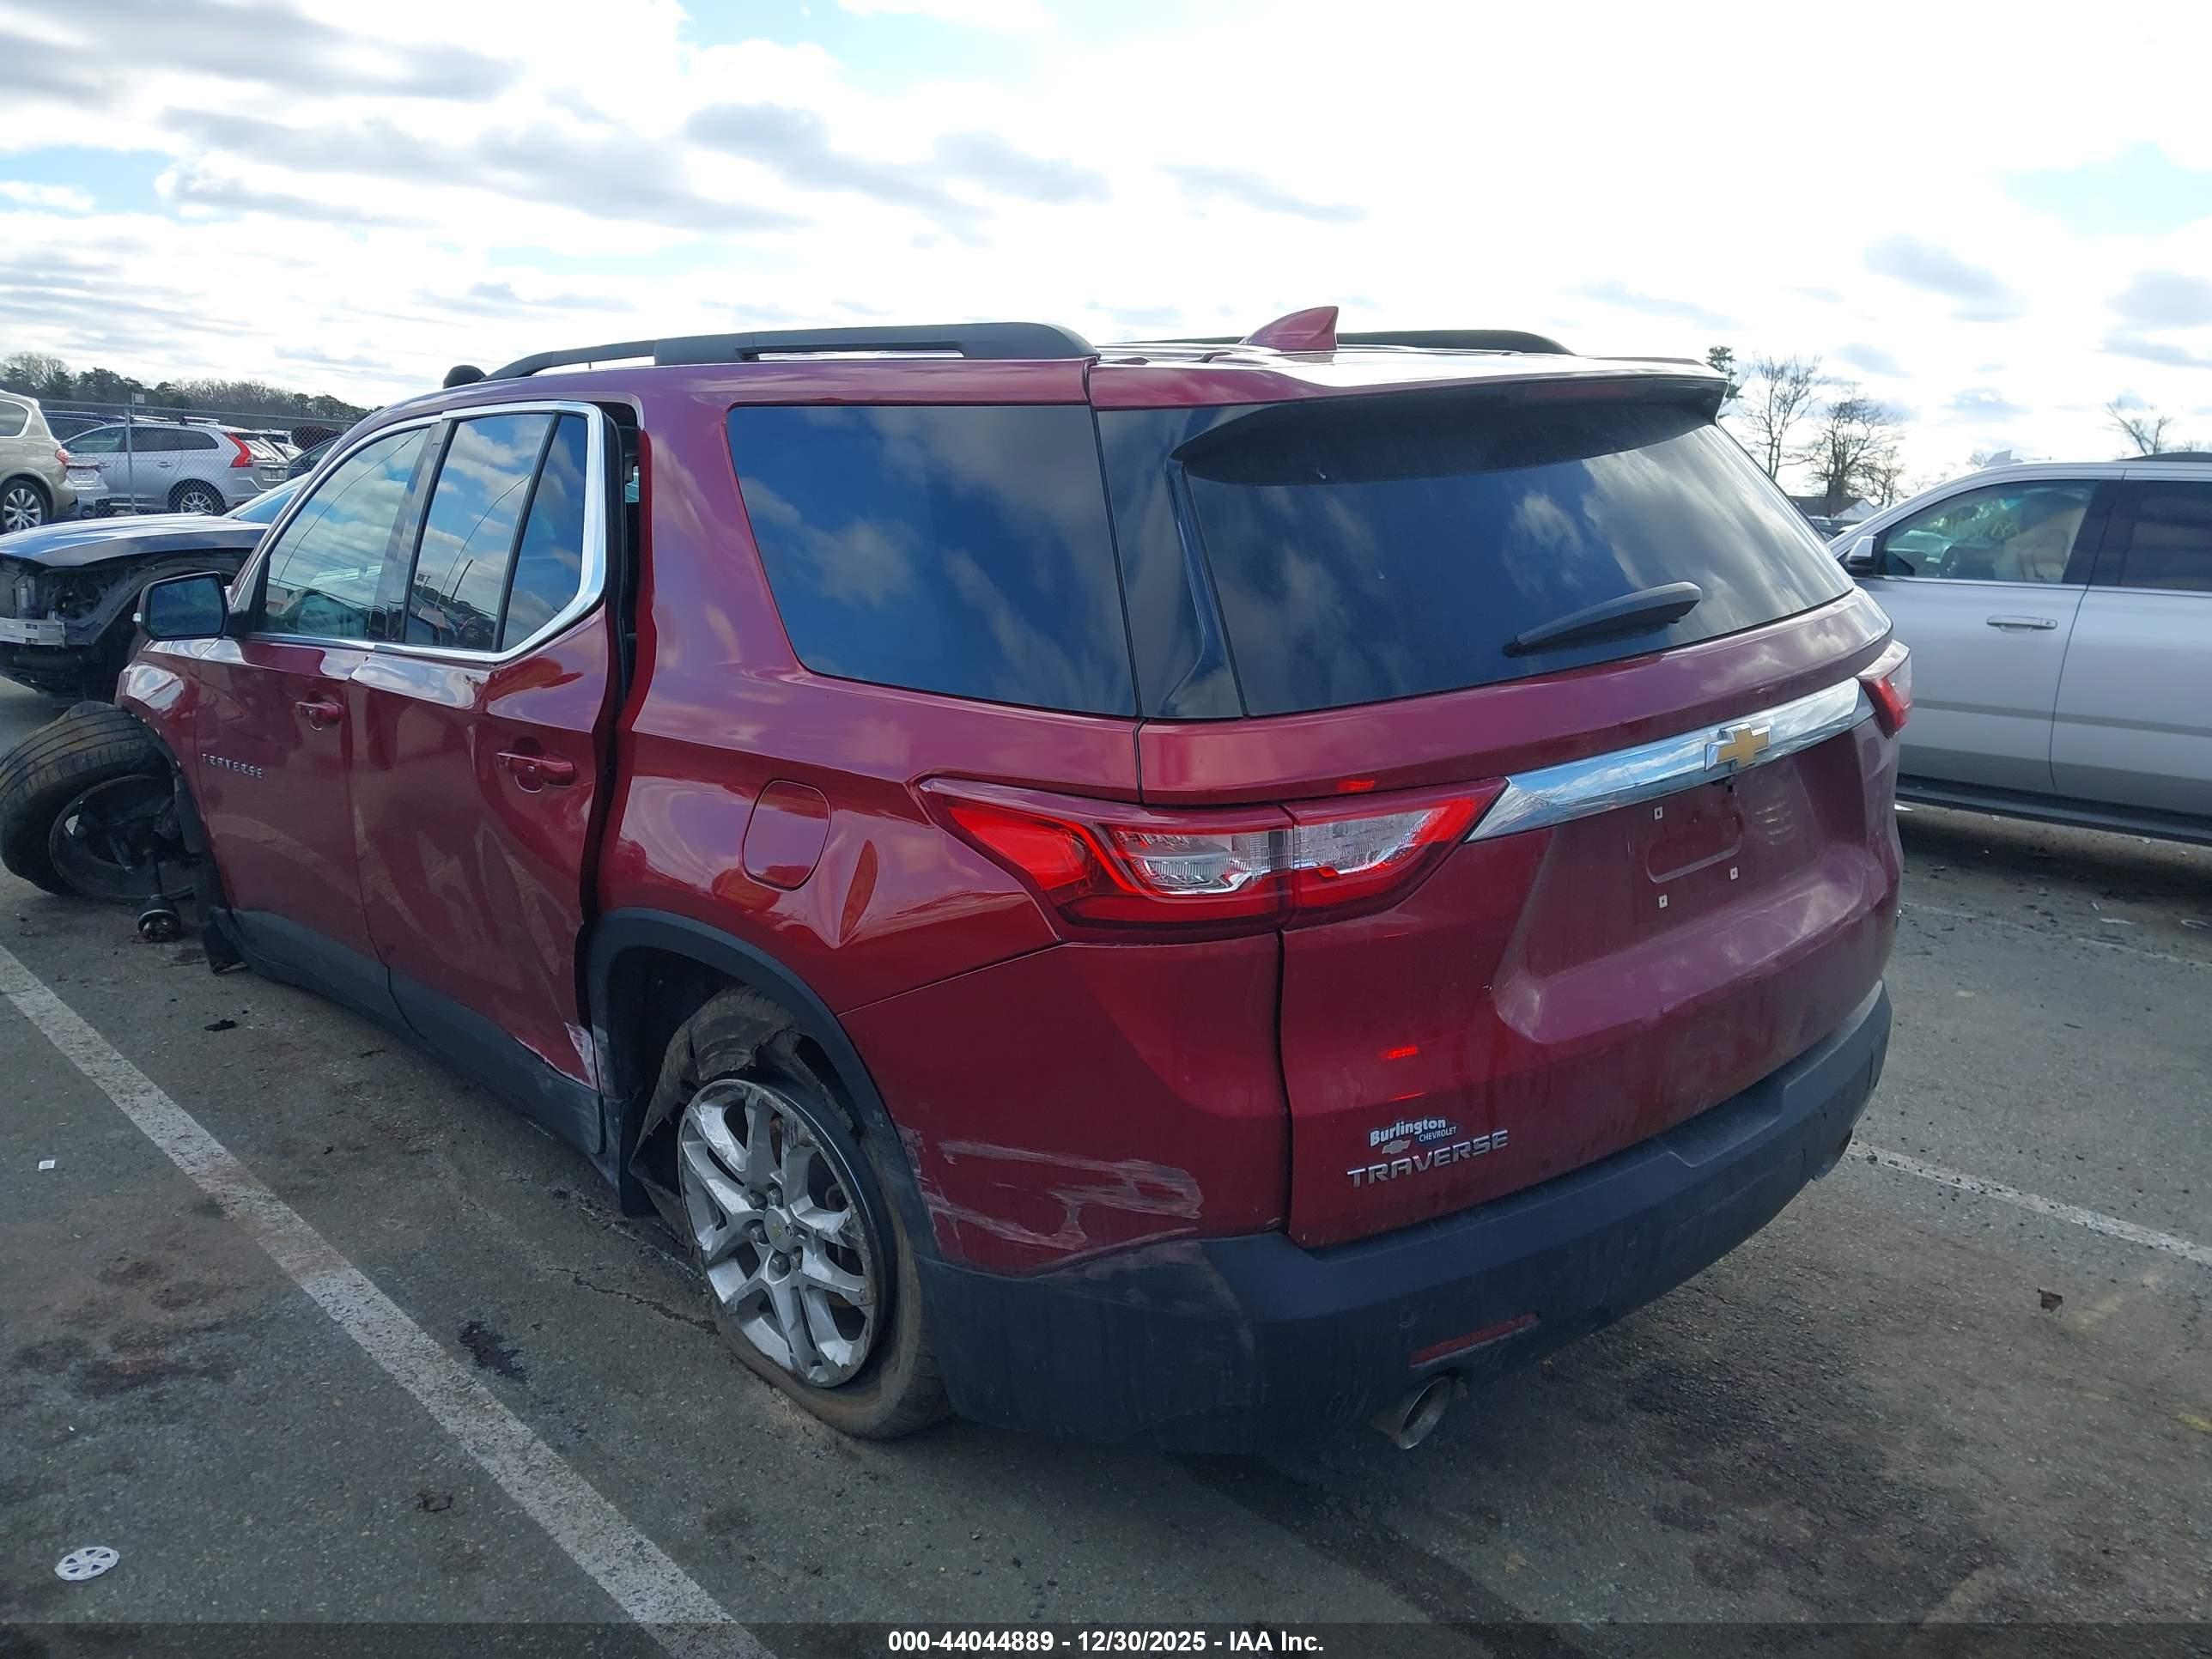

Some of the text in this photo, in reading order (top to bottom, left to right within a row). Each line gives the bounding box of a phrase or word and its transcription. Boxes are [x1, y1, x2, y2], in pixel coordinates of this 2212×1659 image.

[201, 753, 264, 779] TRAVERSE
[1370, 1118, 1446, 1147] Burlington
[1419, 1126, 1457, 1143] CHEVROLET
[1346, 1129, 1509, 1188] TRAVERSE
